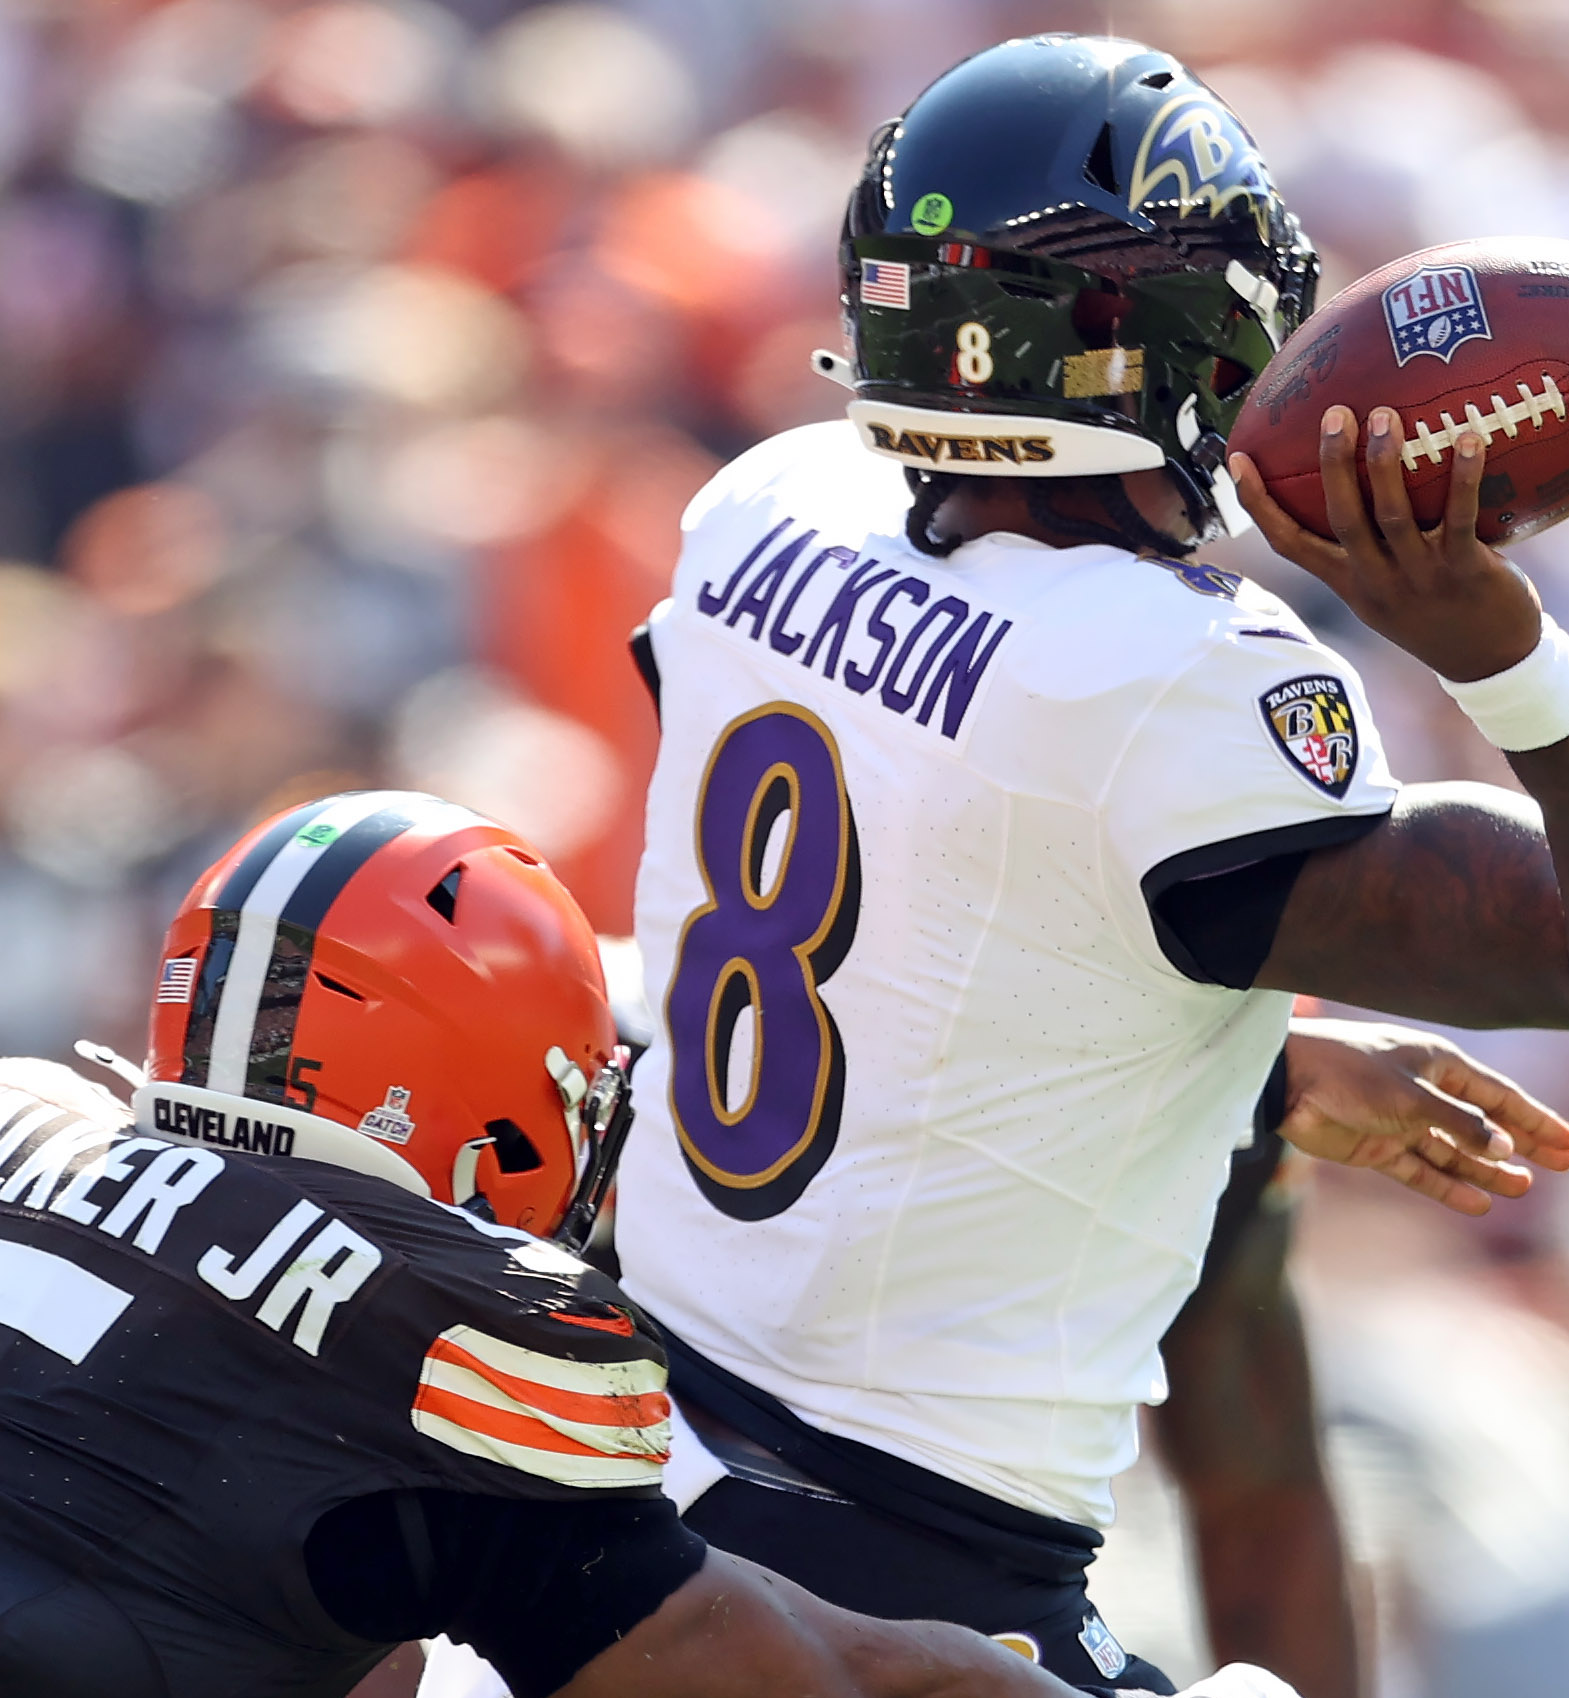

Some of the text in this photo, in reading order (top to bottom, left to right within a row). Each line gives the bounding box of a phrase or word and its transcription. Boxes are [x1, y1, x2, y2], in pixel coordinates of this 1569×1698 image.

[1394, 272, 1469, 320] NFL
[956, 321, 994, 384] 8
[867, 422, 1056, 466] RAVENS
[696, 516, 1013, 741] JACKSON
[1265, 679, 1339, 710] RAVENS
[665, 699, 862, 1223] 8
[284, 1056, 323, 1114] 5
[153, 1097, 296, 1157] CLEVELAND
[196, 1198, 383, 1357] JR
